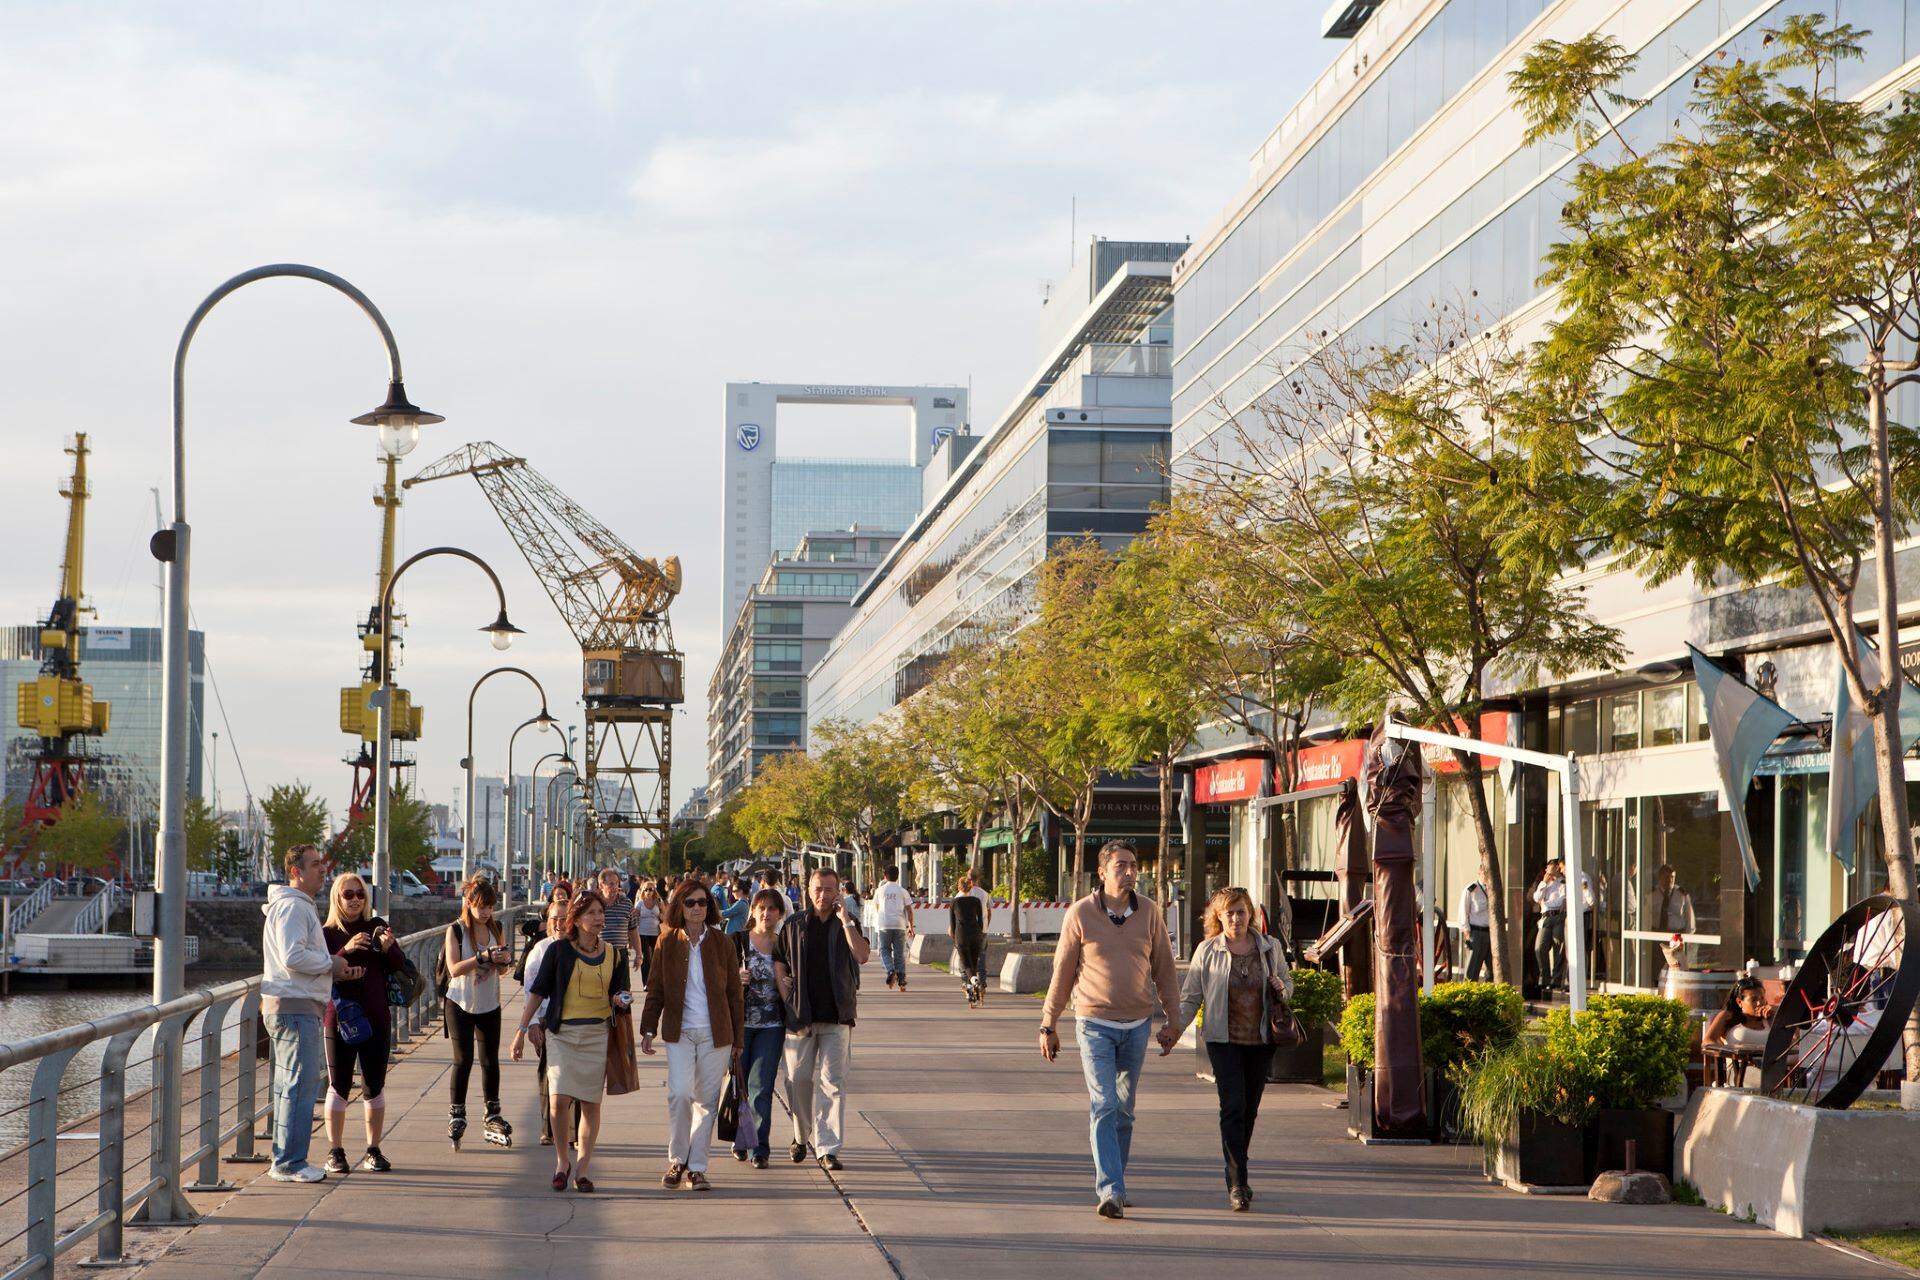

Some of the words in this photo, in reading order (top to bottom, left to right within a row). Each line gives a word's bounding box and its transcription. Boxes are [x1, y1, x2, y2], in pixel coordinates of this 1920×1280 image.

[804, 386, 856, 396] Standard
[860, 386, 888, 397] Bank
[1303, 755, 1330, 782] Santander
[1216, 769, 1237, 794] Santander
